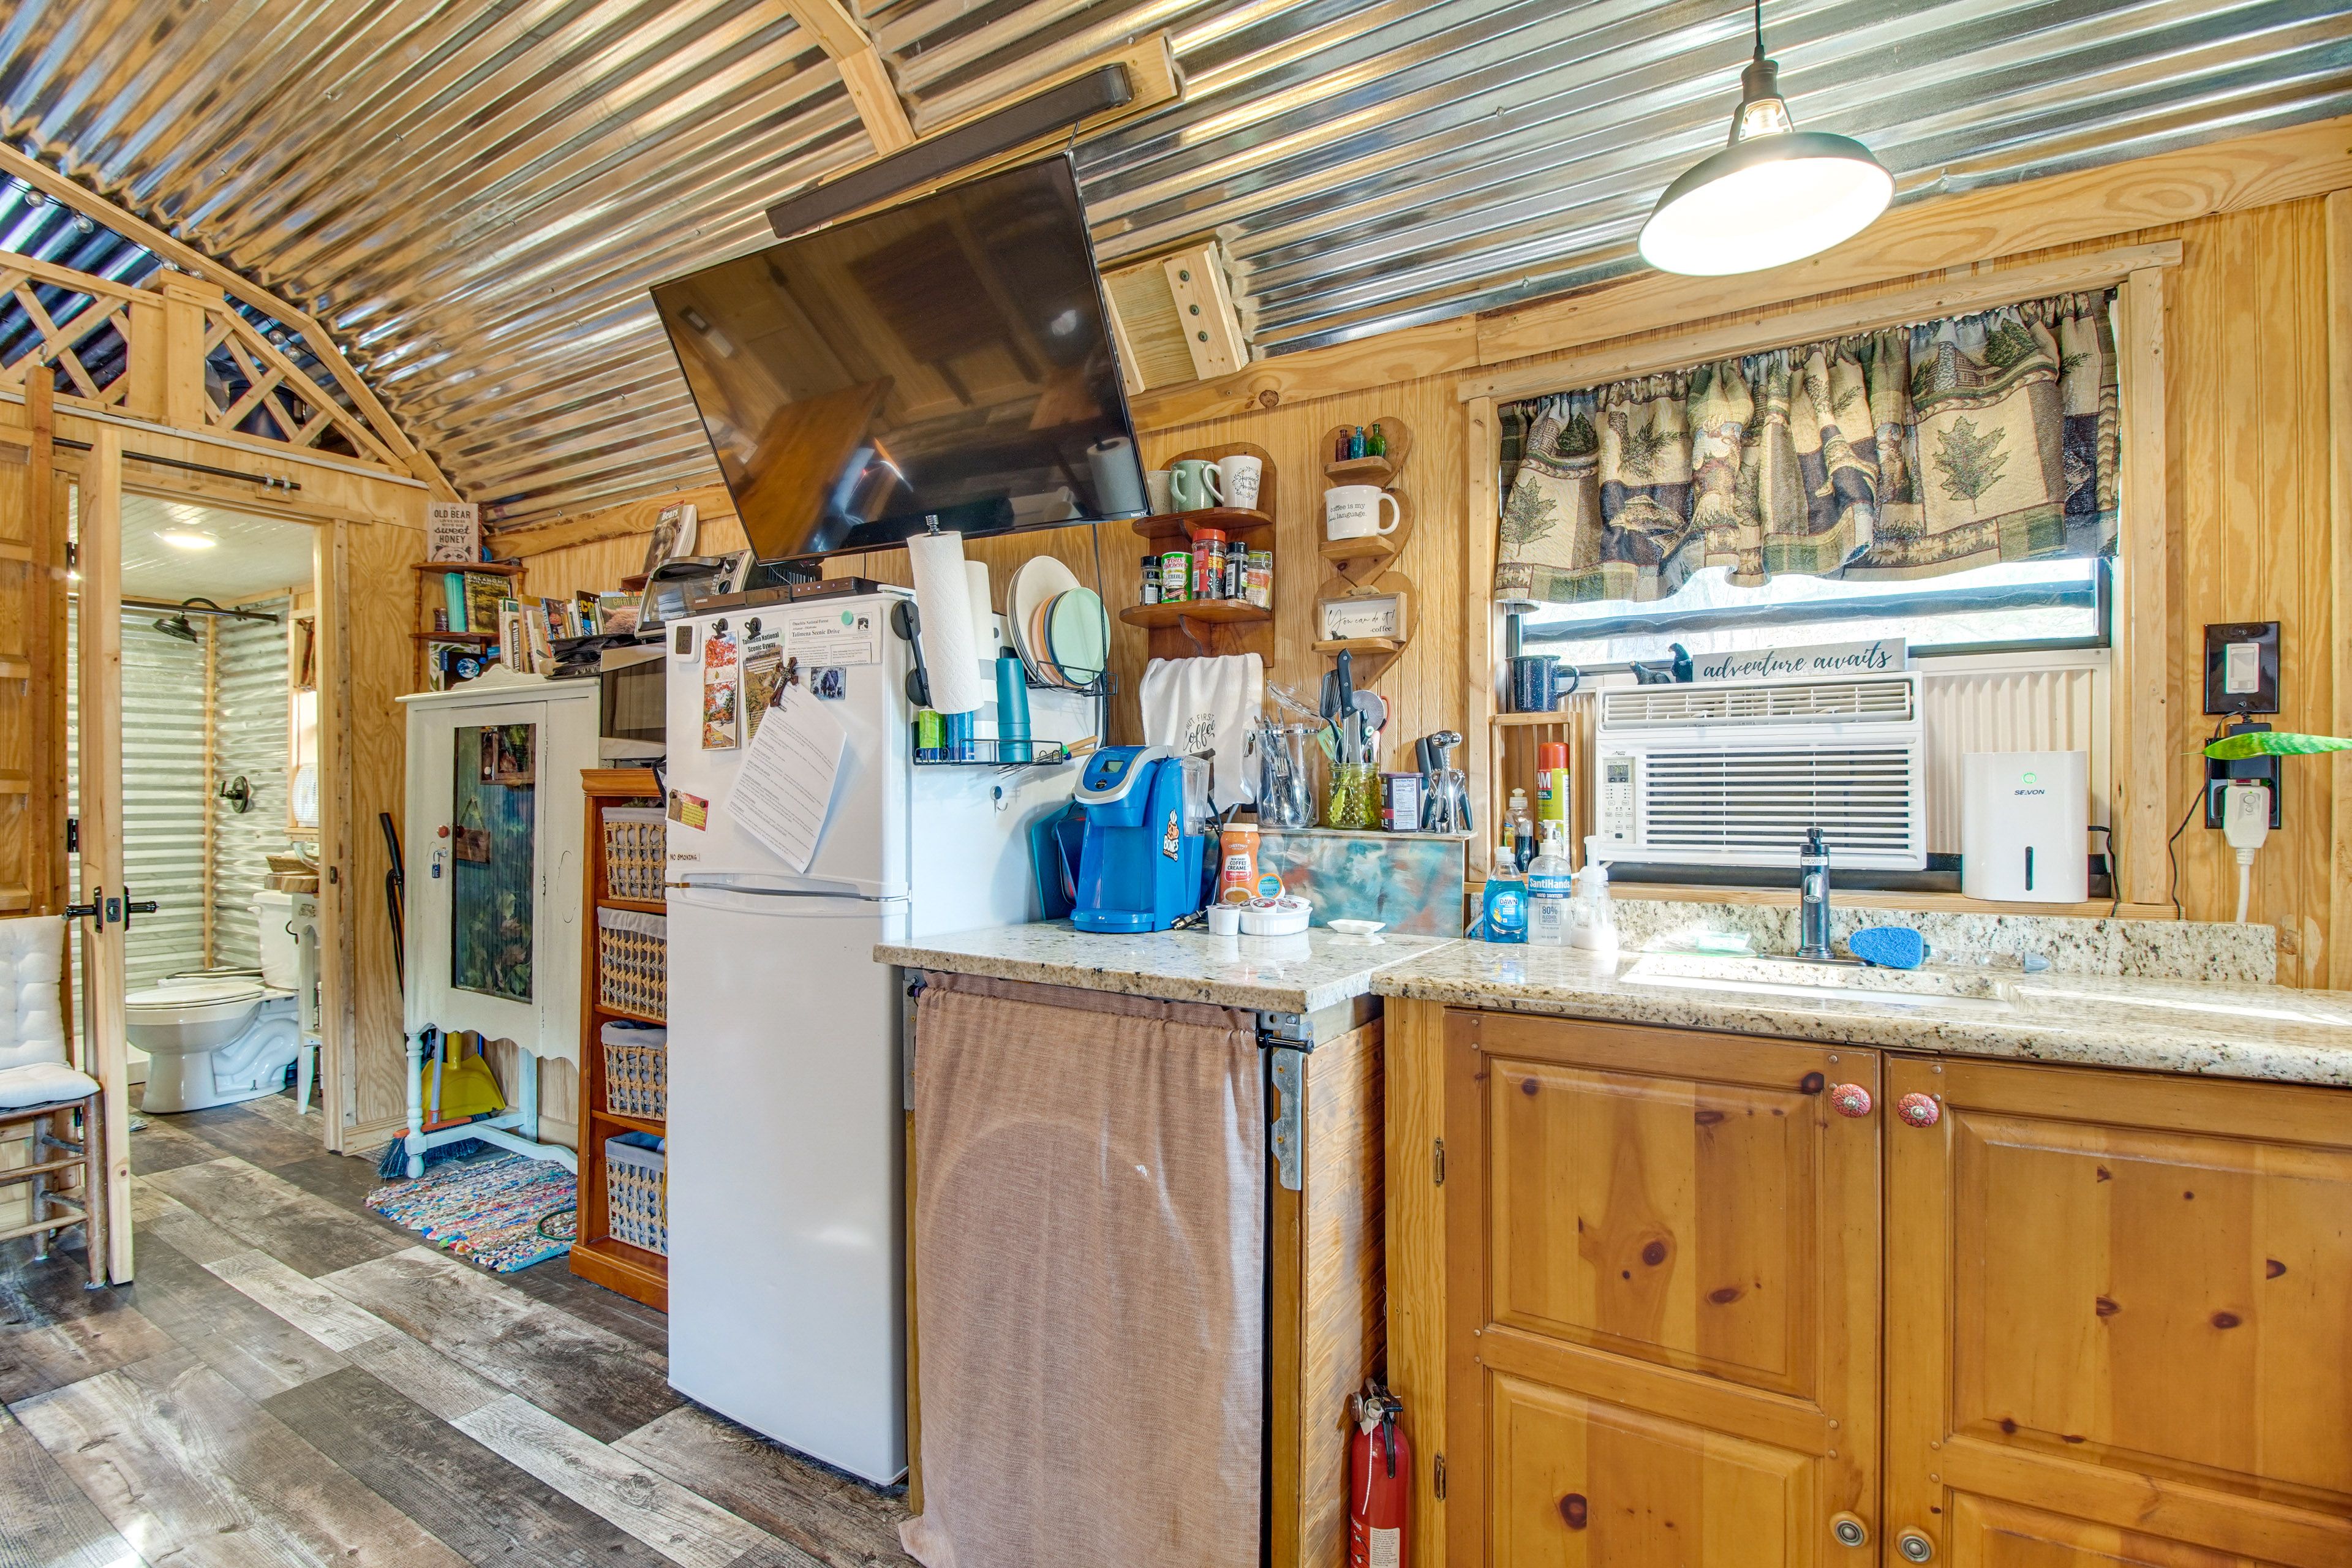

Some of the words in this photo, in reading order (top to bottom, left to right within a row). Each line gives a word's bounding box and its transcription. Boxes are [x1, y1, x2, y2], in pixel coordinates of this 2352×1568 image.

[434, 510, 448, 518] OLD
[451, 510, 471, 519] BEAR
[662, 509, 679, 521] Bears
[434, 526, 471, 535] sweet
[439, 535, 466, 543] HONEY
[467, 575, 507, 584] OKLAHOMA
[612, 597, 630, 606] GREAT
[1328, 609, 1352, 631] You
[1372, 611, 1378, 622] do
[742, 636, 761, 646] Talimena
[761, 631, 780, 641] National
[748, 644, 763, 653] Scenic
[763, 641, 776, 650] Byway
[1703, 650, 1807, 679] adventure
[1813, 641, 1893, 669] awaits
[1186, 717, 1195, 730] BUT
[1197, 713, 1215, 722] FIRST
[1164, 834, 1179, 853] BONES
[1529, 878, 1570, 889] SantiHands
[1542, 907, 1558, 915] 80%
